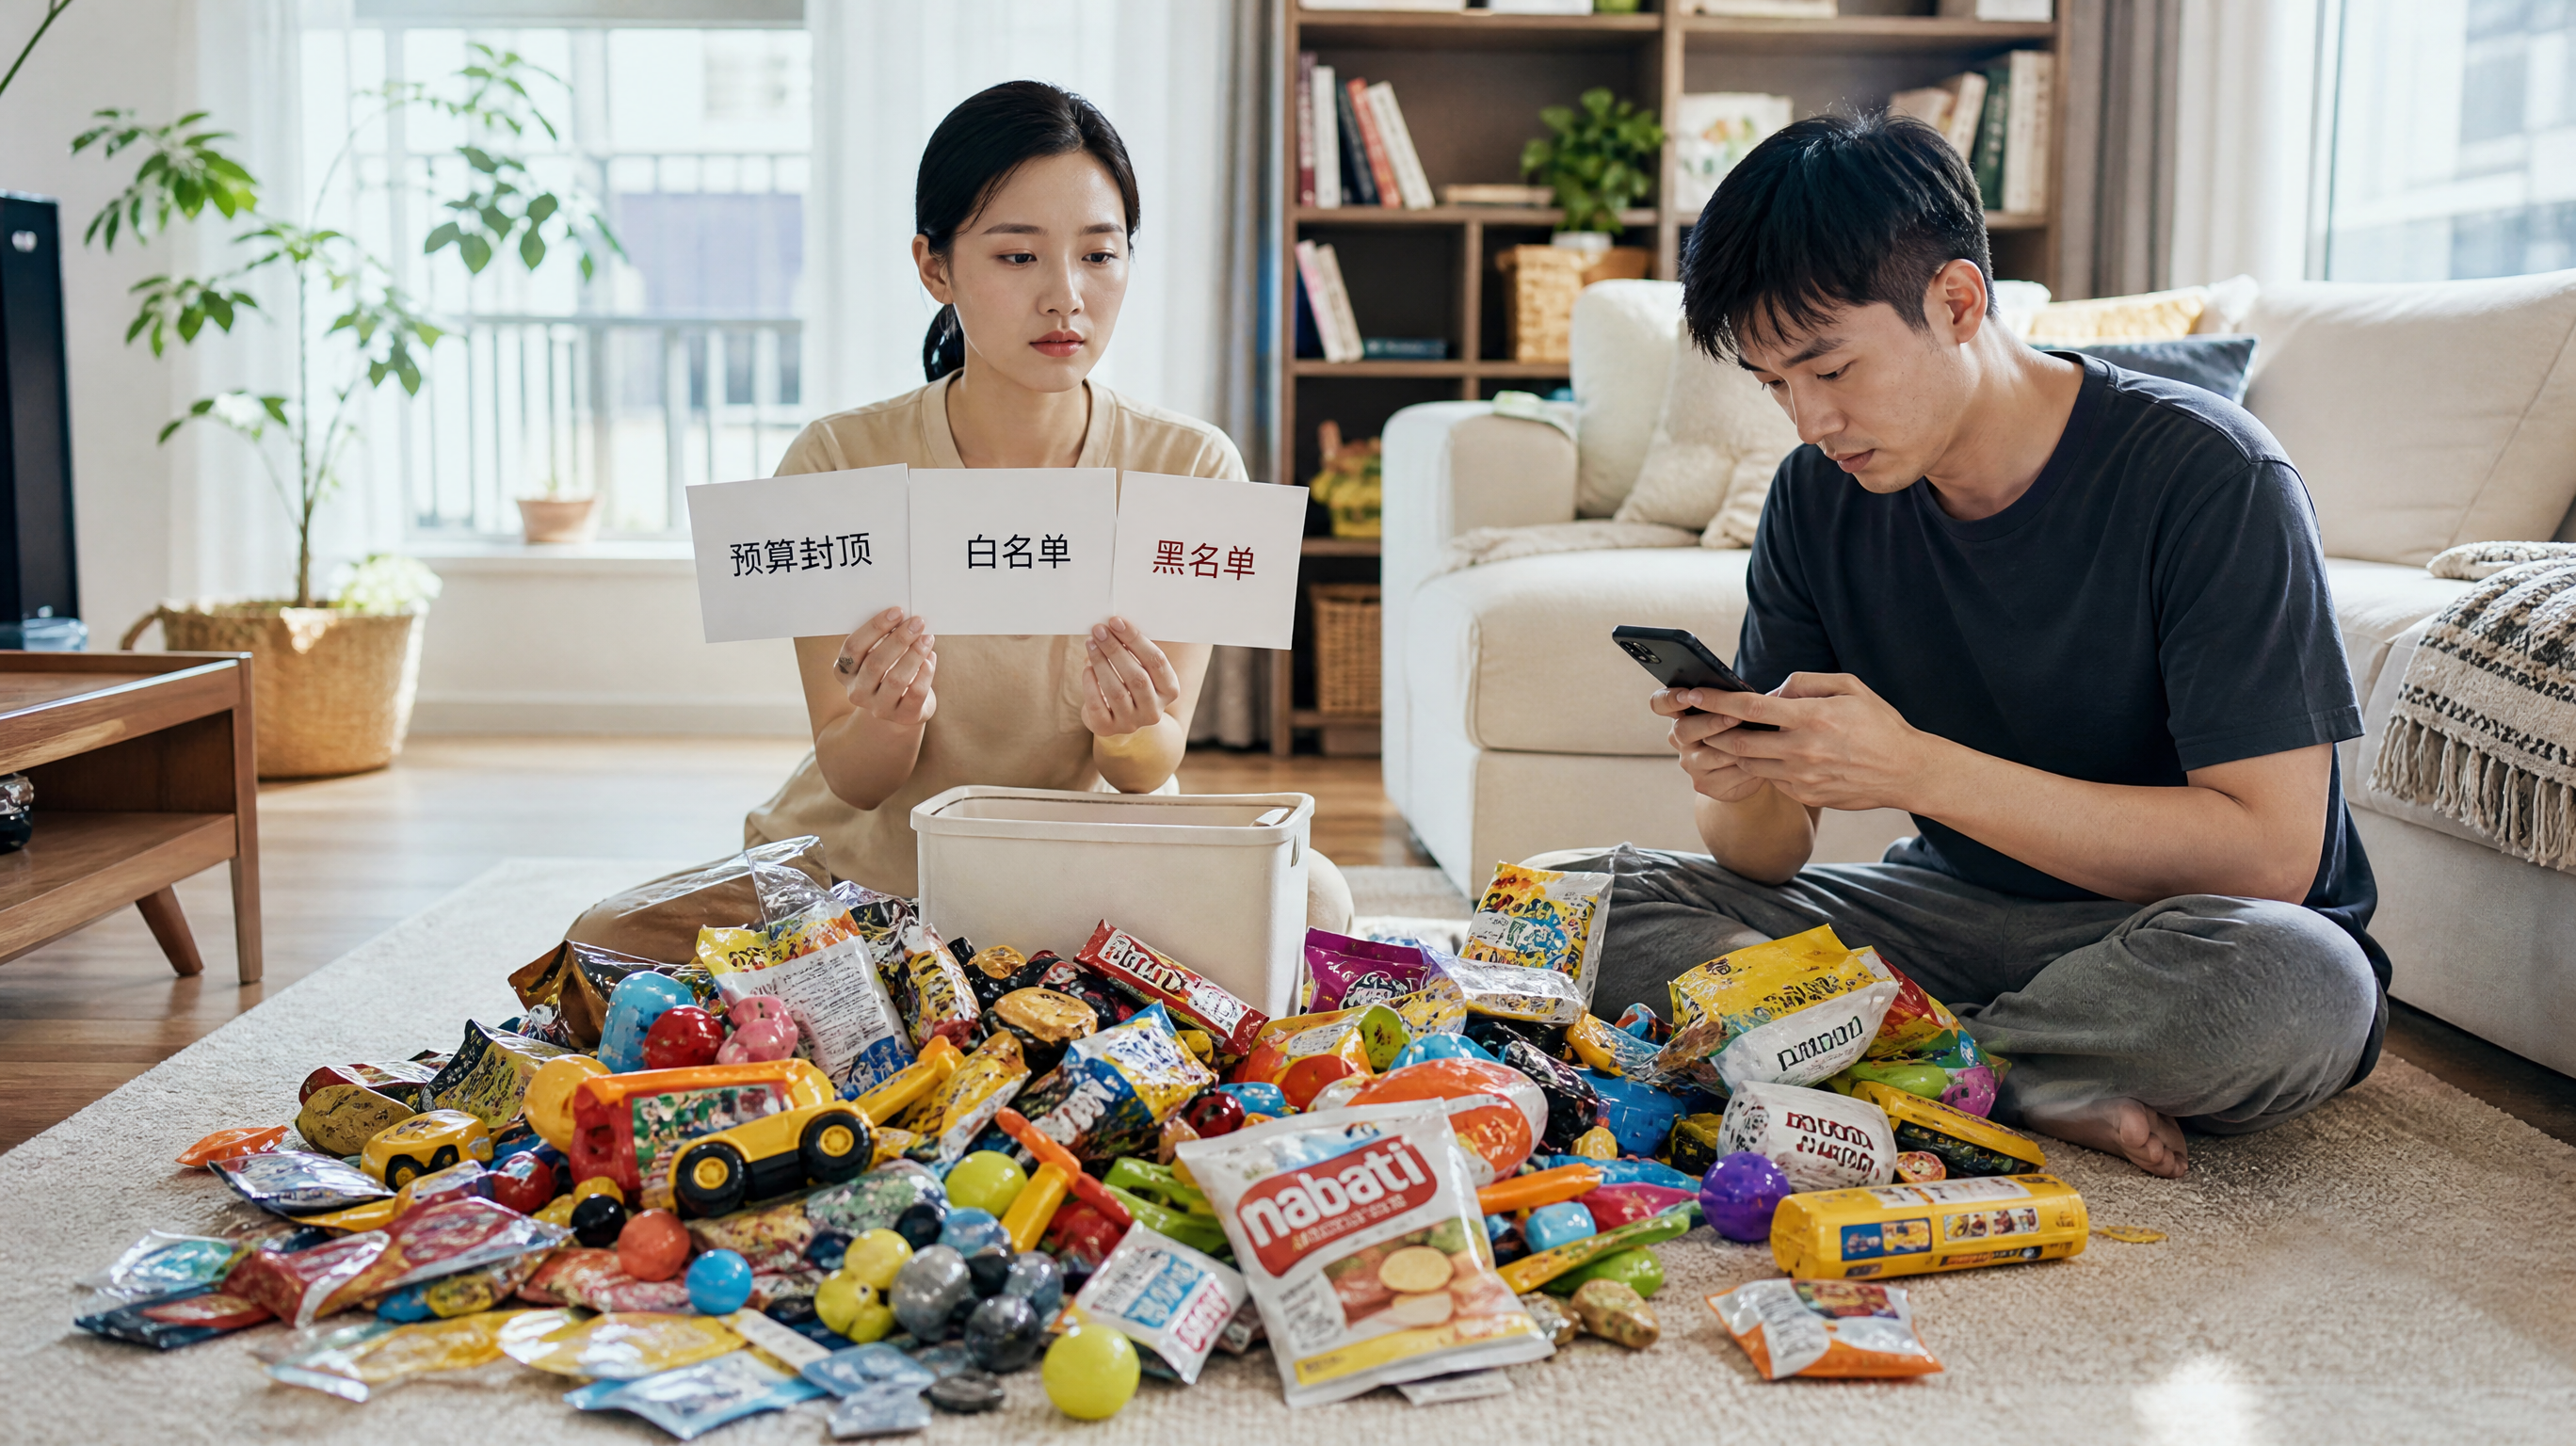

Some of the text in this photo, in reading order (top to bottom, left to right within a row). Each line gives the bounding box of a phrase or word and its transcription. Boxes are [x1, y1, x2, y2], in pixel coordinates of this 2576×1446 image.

[729, 532, 873, 577] 预算封顶
[967, 533, 1071, 570] 白名单
[1151, 539, 1256, 582] 黑名单
[1240, 1141, 1425, 1248] nabati
